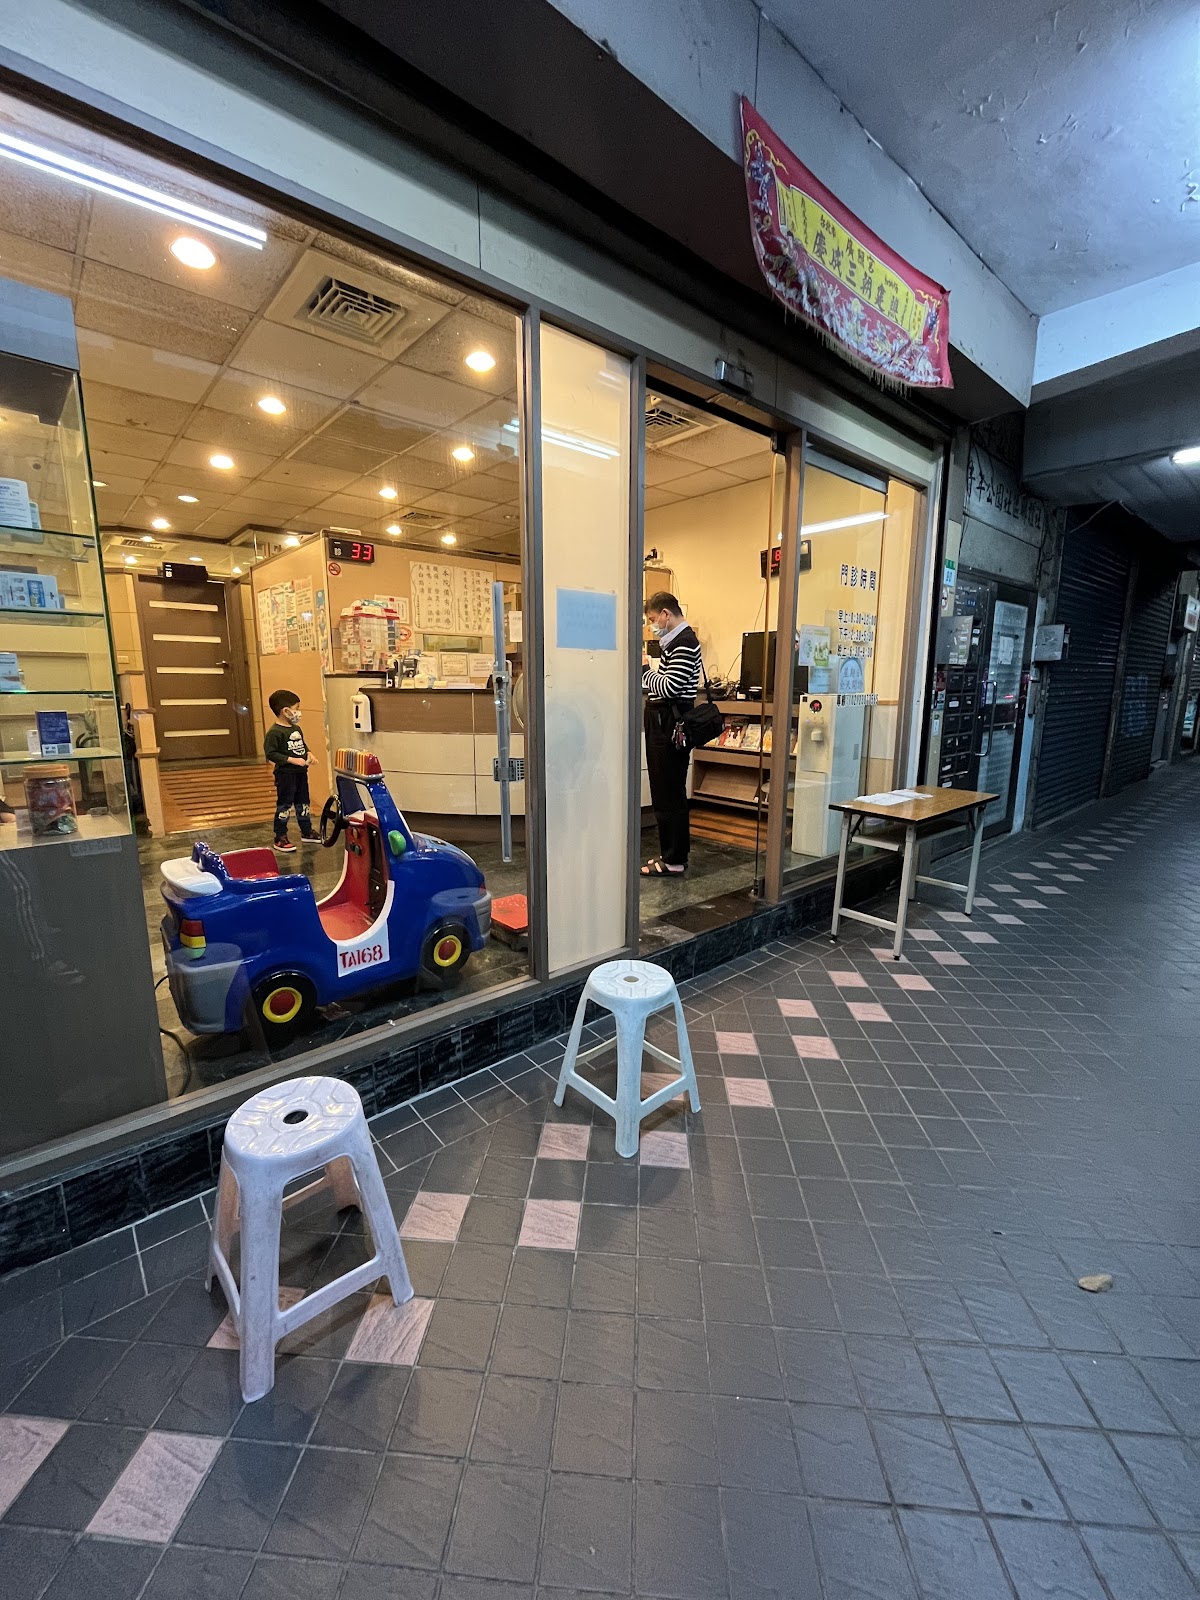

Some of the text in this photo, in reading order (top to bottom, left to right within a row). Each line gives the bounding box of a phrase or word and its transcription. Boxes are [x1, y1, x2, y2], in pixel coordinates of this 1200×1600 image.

[351, 543, 373, 560] 33
[841, 564, 876, 591] 門診時間
